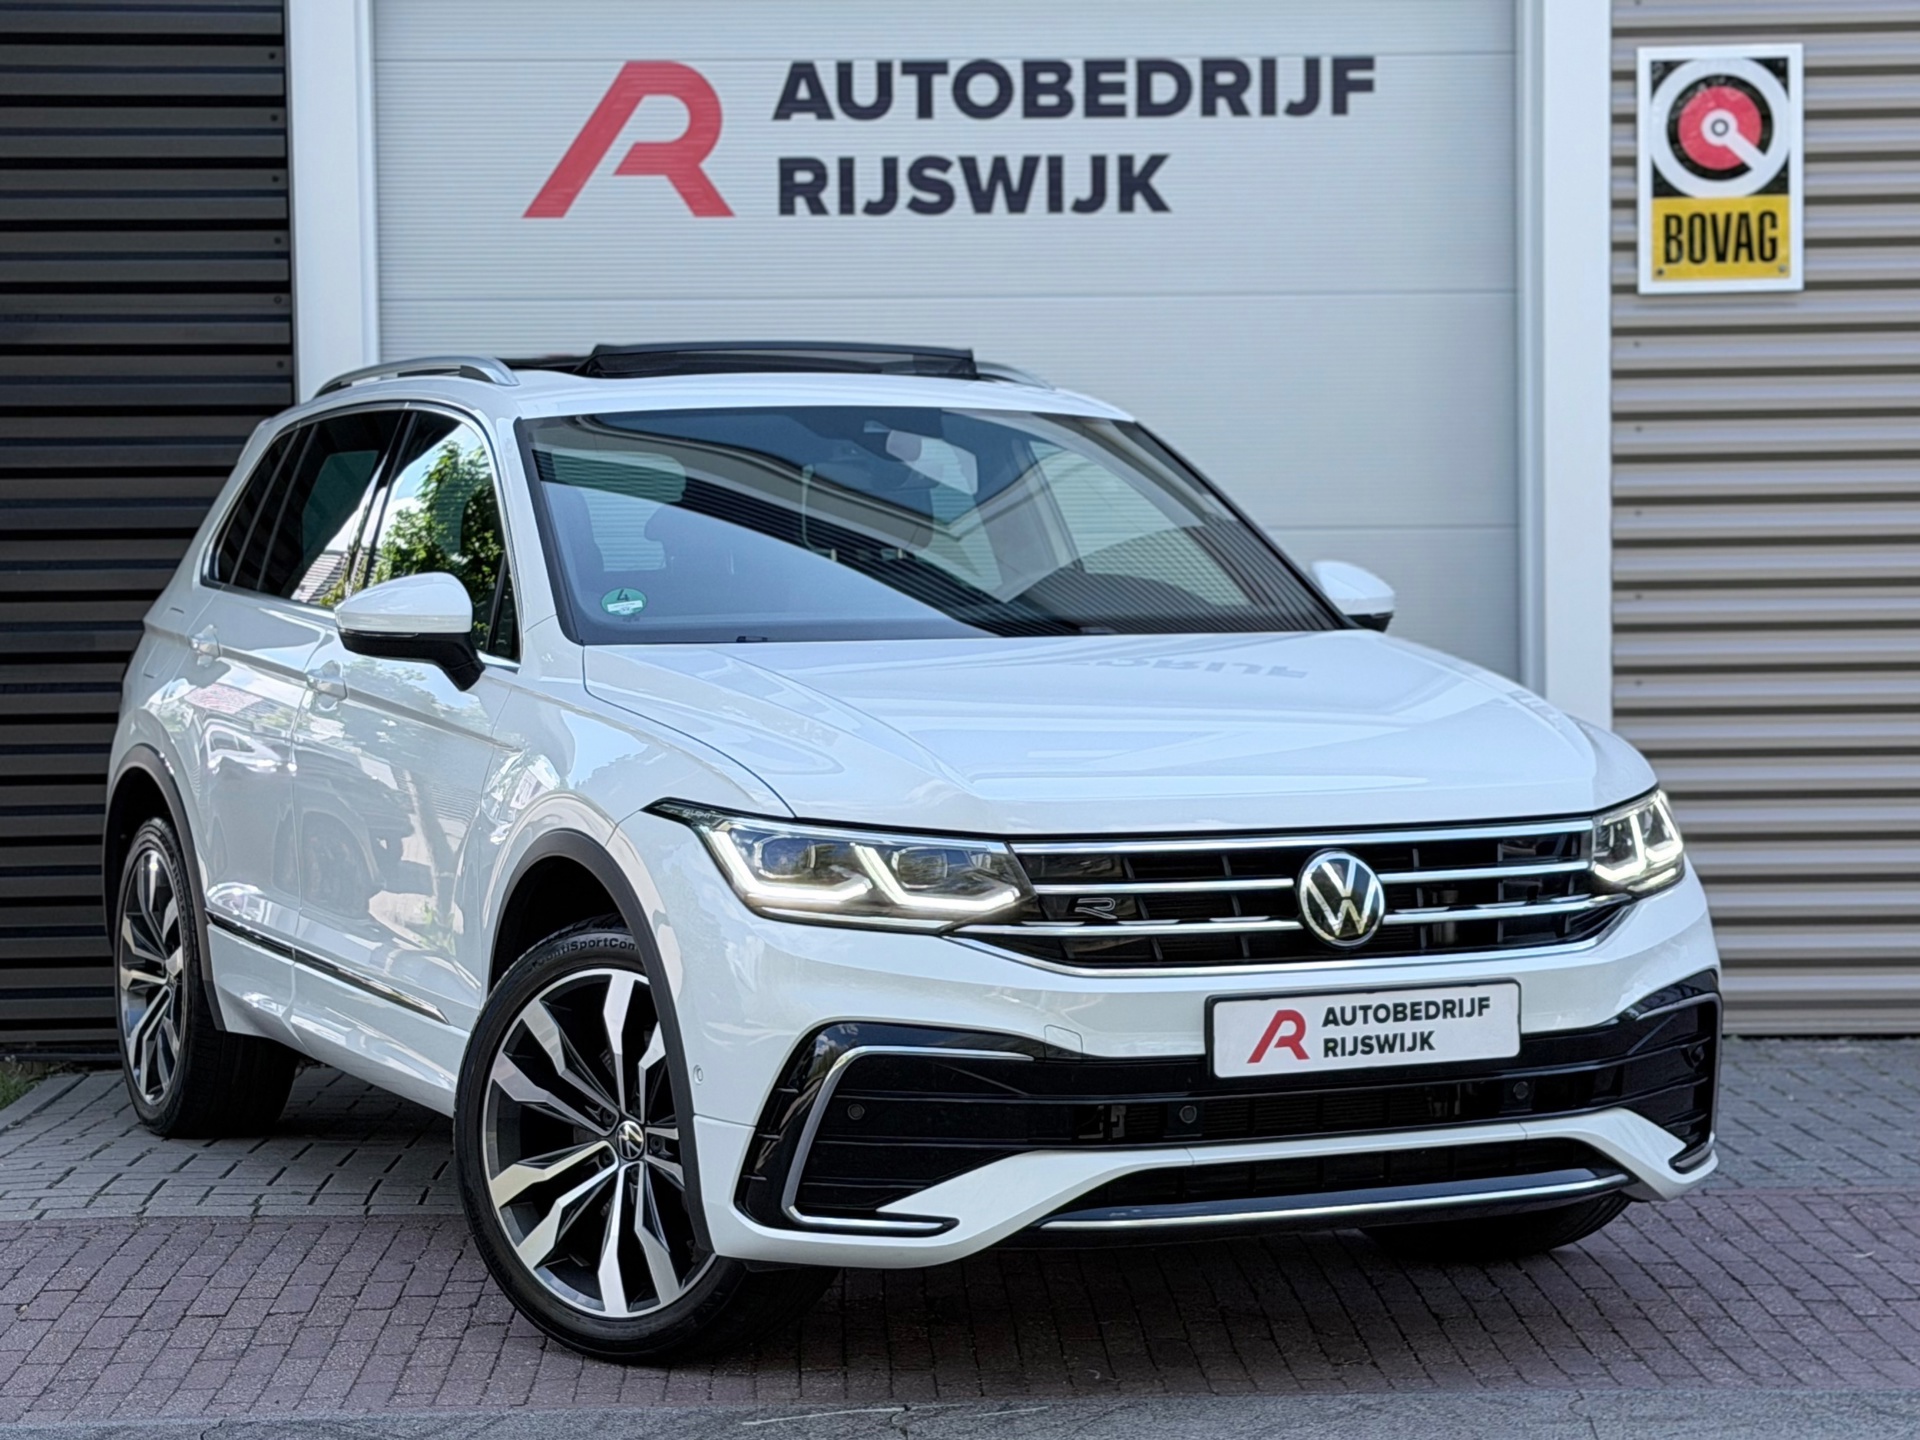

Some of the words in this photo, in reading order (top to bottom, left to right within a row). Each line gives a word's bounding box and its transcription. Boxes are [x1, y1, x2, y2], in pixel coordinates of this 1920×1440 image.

[772, 56, 1376, 121] AUTOBEDRIJF
[777, 153, 1172, 217] RIJSWIJK
[1663, 210, 1778, 264] BOVAG
[1321, 996, 1491, 1028] AUTOBEDRIJF
[1322, 1030, 1436, 1058] RIJSWIJK
